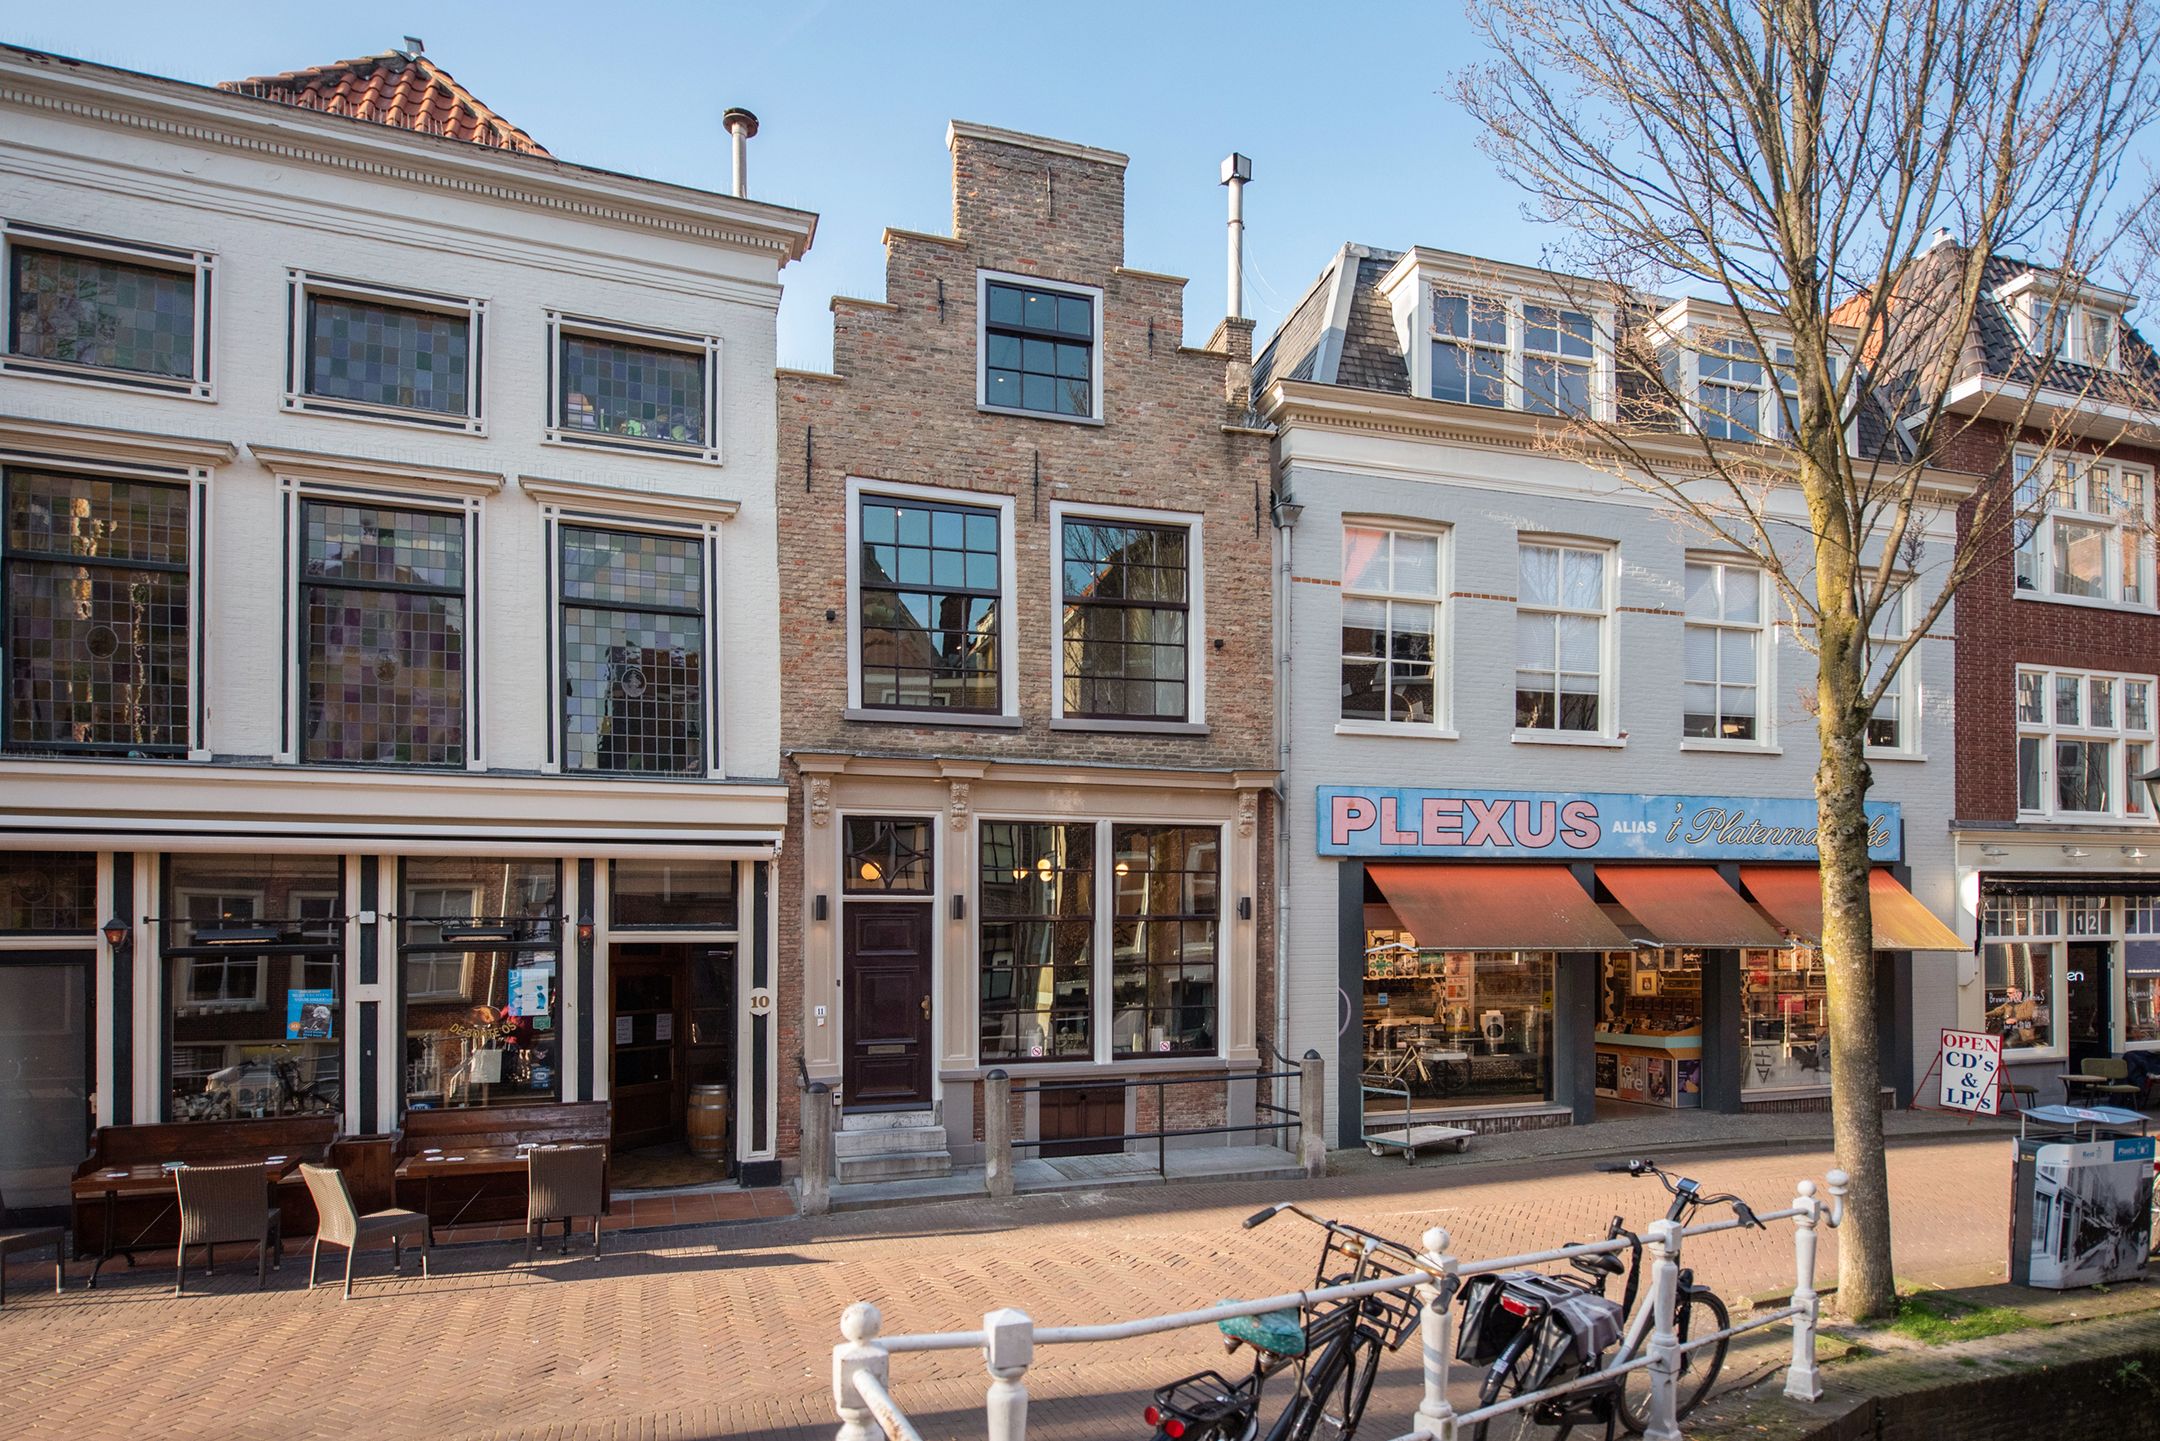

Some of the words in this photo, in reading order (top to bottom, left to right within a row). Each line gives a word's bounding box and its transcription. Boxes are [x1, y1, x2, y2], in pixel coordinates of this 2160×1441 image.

[1331, 795, 1600, 849] PLEXUS
[1612, 821, 1657, 834] ALIAS
[1685, 807, 1890, 848] Platenmake
[2077, 915, 2097, 930] 12
[751, 995, 770, 1009] 10
[449, 1023, 464, 1035] DE
[501, 1022, 517, 1034] OS
[1943, 1033, 2000, 1053] OPEN
[1945, 1051, 1994, 1072] CD's
[1961, 1072, 1978, 1088] &
[1946, 1087, 1991, 1110] LP's
